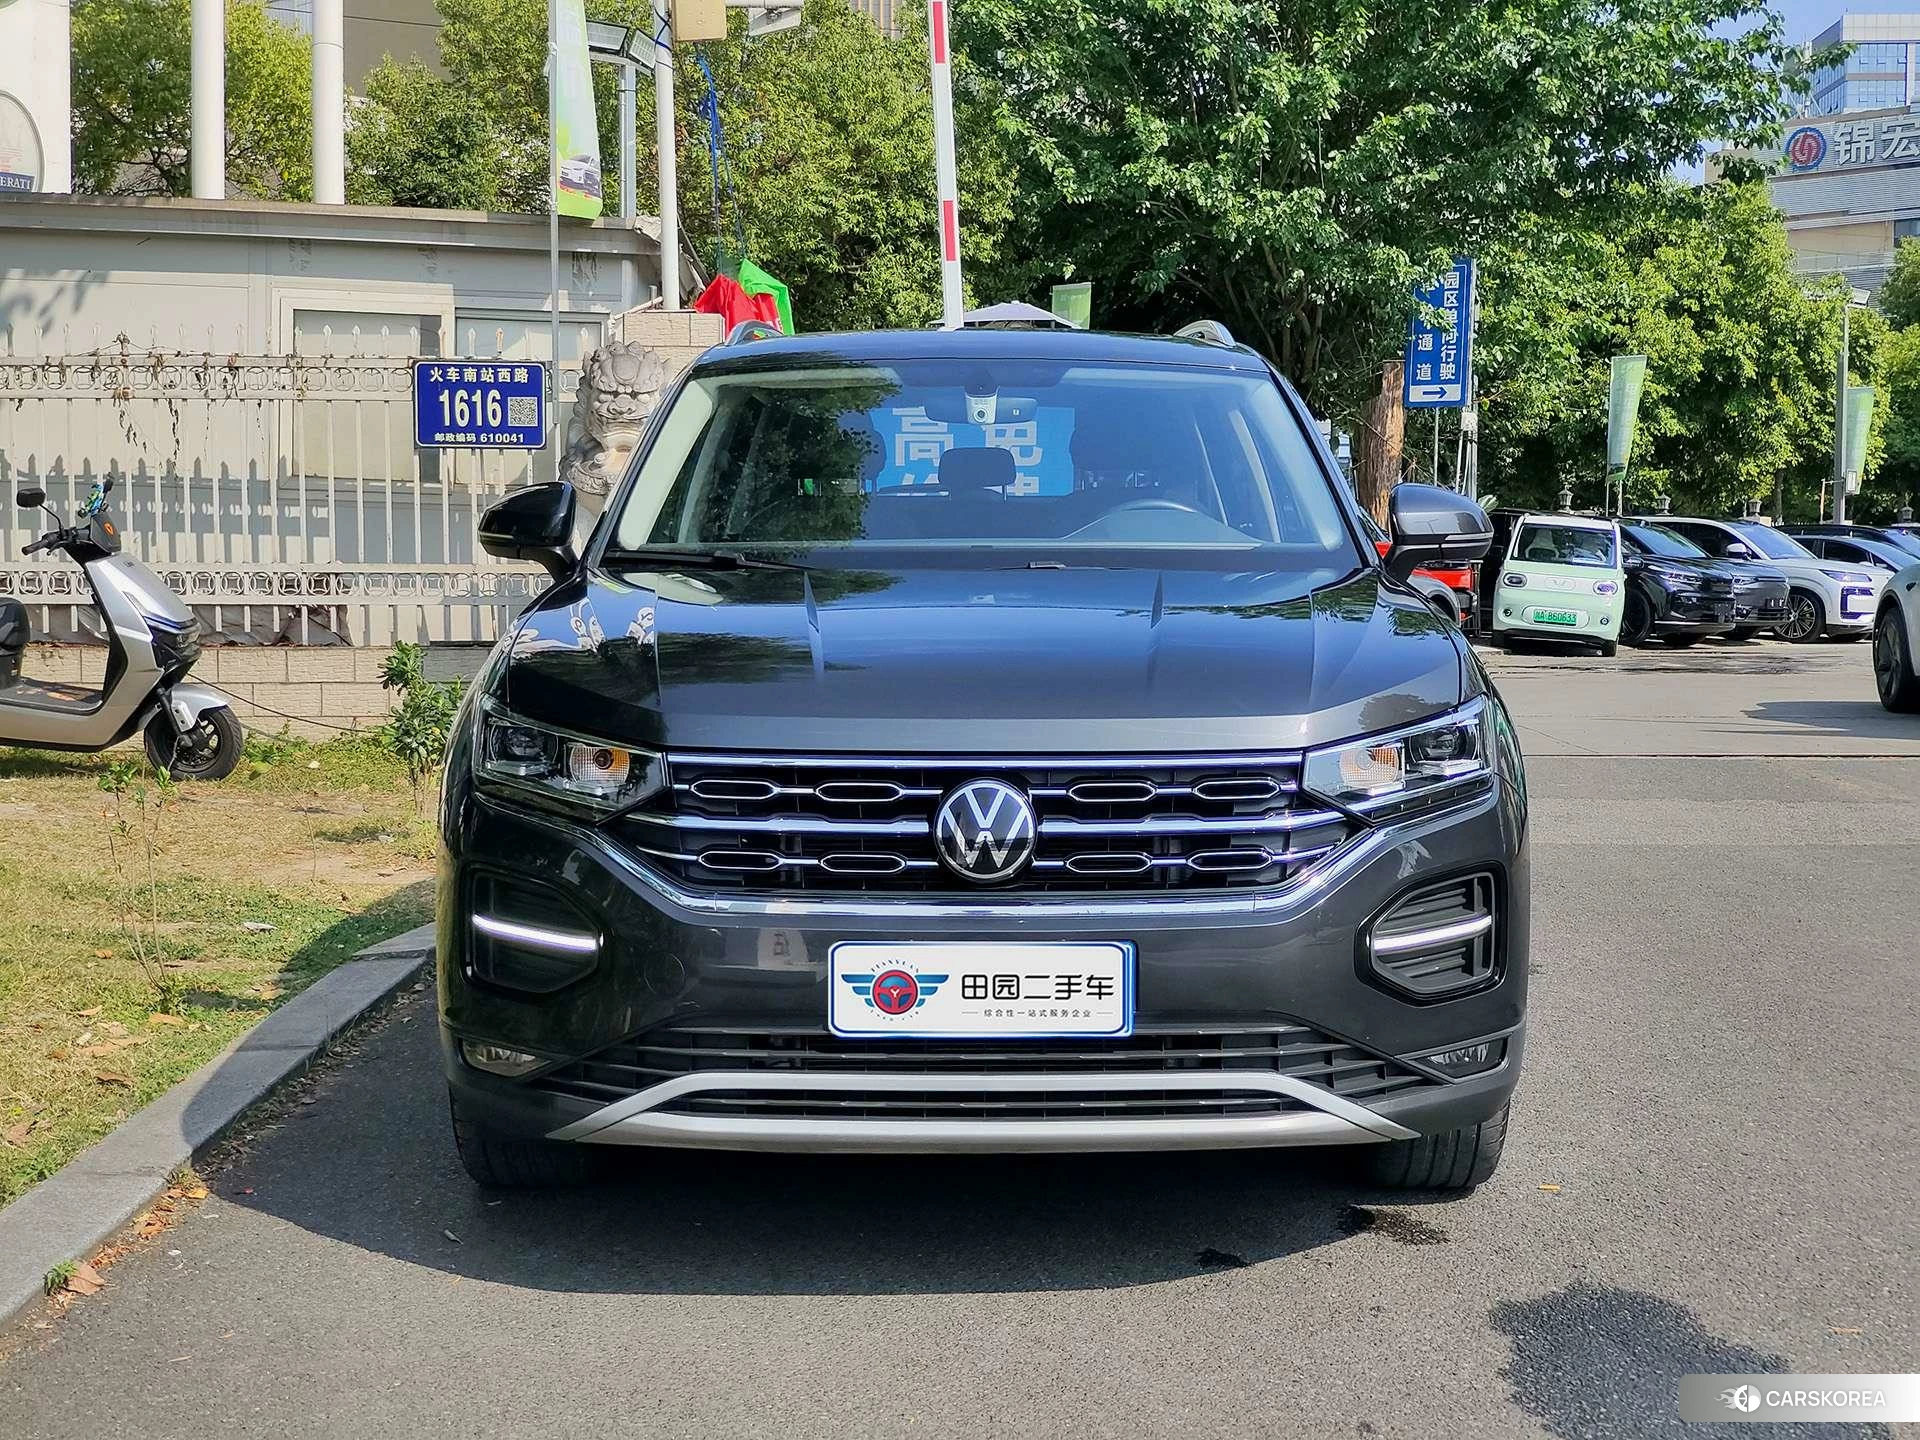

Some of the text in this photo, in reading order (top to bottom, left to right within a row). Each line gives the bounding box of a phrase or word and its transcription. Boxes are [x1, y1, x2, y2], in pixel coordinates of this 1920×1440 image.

[1834, 115, 1920, 166] 锦宏
[430, 366, 529, 384] 火车南站西路
[439, 389, 502, 428] 1616
[434, 432, 525, 443] 邮政编码 610041
[961, 974, 1114, 1001] 田园二手车
[983, 1008, 1092, 1018] 综合性一站式服务企业
